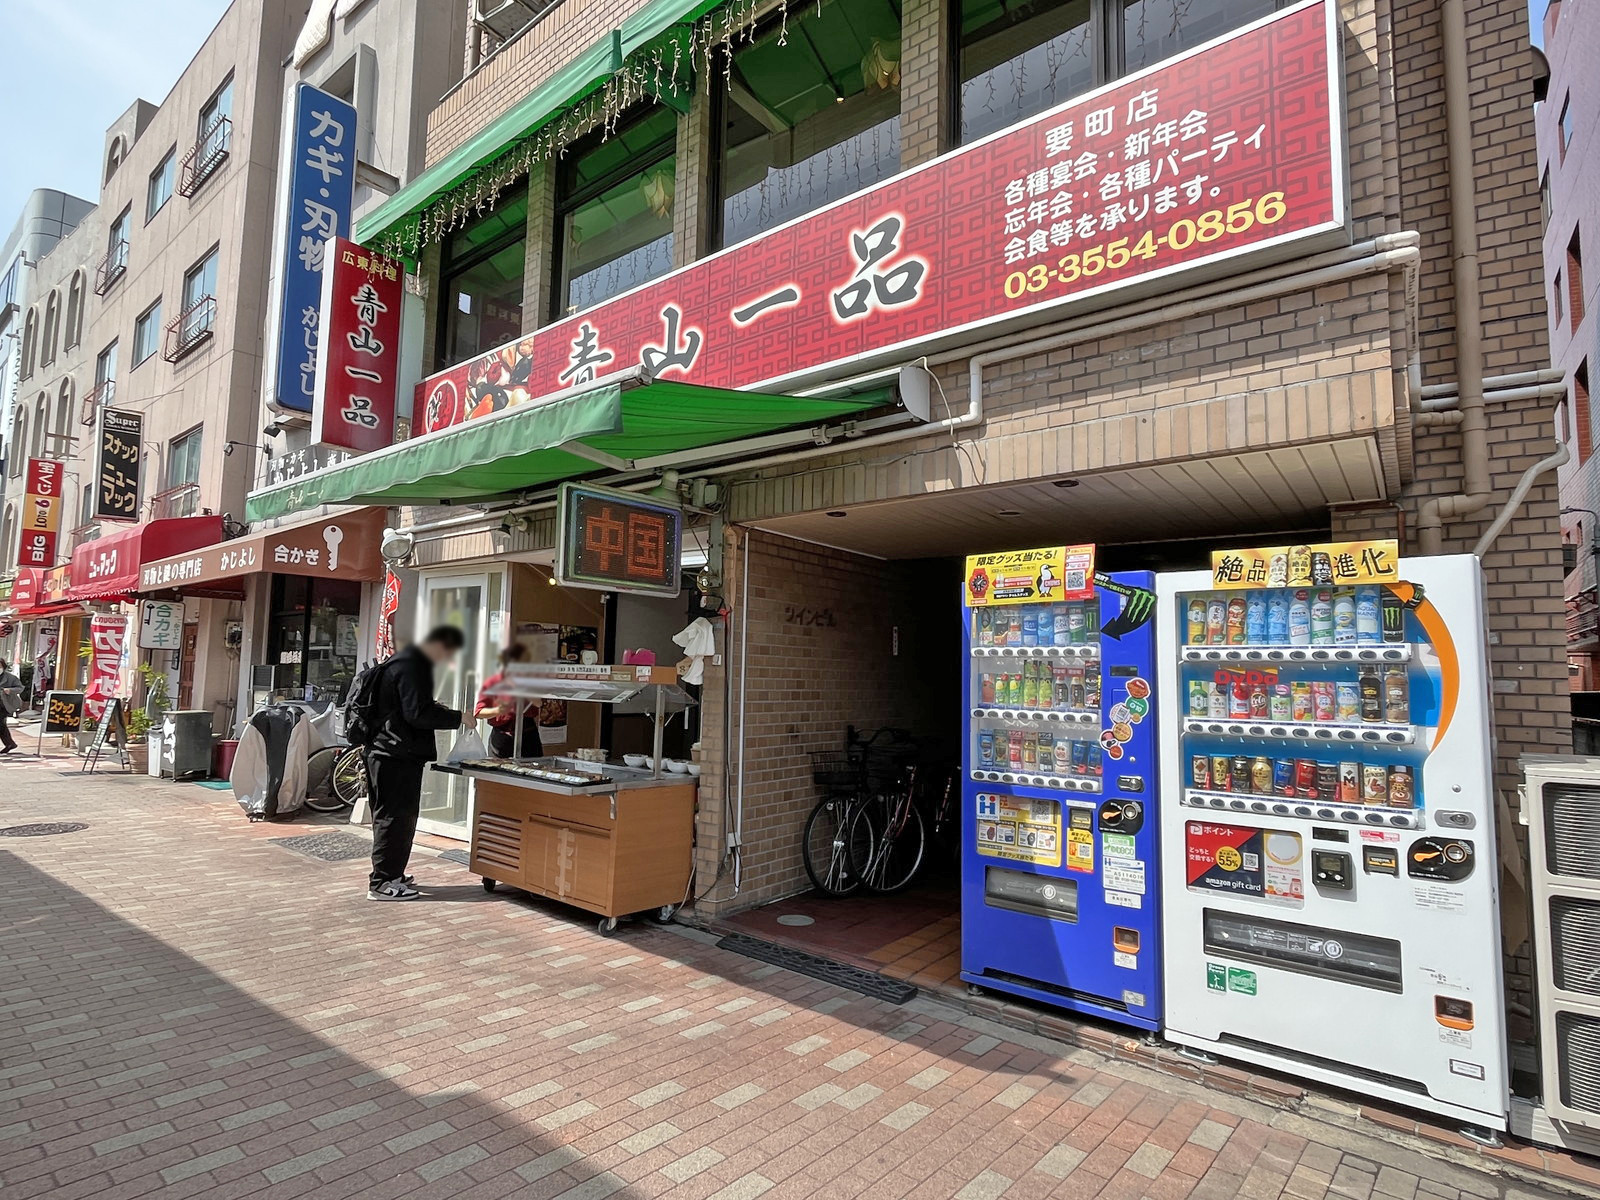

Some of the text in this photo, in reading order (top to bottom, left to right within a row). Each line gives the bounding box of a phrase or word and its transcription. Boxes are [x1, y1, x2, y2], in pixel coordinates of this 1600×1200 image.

[1045, 88, 1158, 158] 要町店
[1004, 109, 1208, 206] 各種宴会・新年会
[299, 110, 344, 272] カギ・刃物
[1003, 124, 1266, 235] 忘年会・各種パーティ
[1003, 174, 1221, 265] 会食等を承ります。
[1003, 191, 1287, 299] 03-3554-0856
[560, 216, 925, 386] 青山一品
[342, 285, 387, 428] 青山一品
[104, 411, 139, 427] Super
[104, 432, 138, 463] スナック
[37, 461, 56, 495] 宝くじ
[102, 463, 137, 488] ニュー
[101, 480, 136, 512] マック
[287, 489, 324, 508] 青山一
[274, 545, 319, 566] 合かぎ
[585, 507, 666, 579] 中国
[143, 547, 256, 585] 刃物と鍵の専門店 かじよし
[1215, 554, 1267, 583] 絶品
[1334, 548, 1394, 578] 進化
[152, 604, 172, 646] 合カギ
[1214, 670, 1278, 689] DyDo
[48, 711, 80, 727] ニューマック
[50, 699, 75, 713] スナック
[1204, 825, 1234, 836] ポイント
[1206, 877, 1261, 891] amazon gift card
